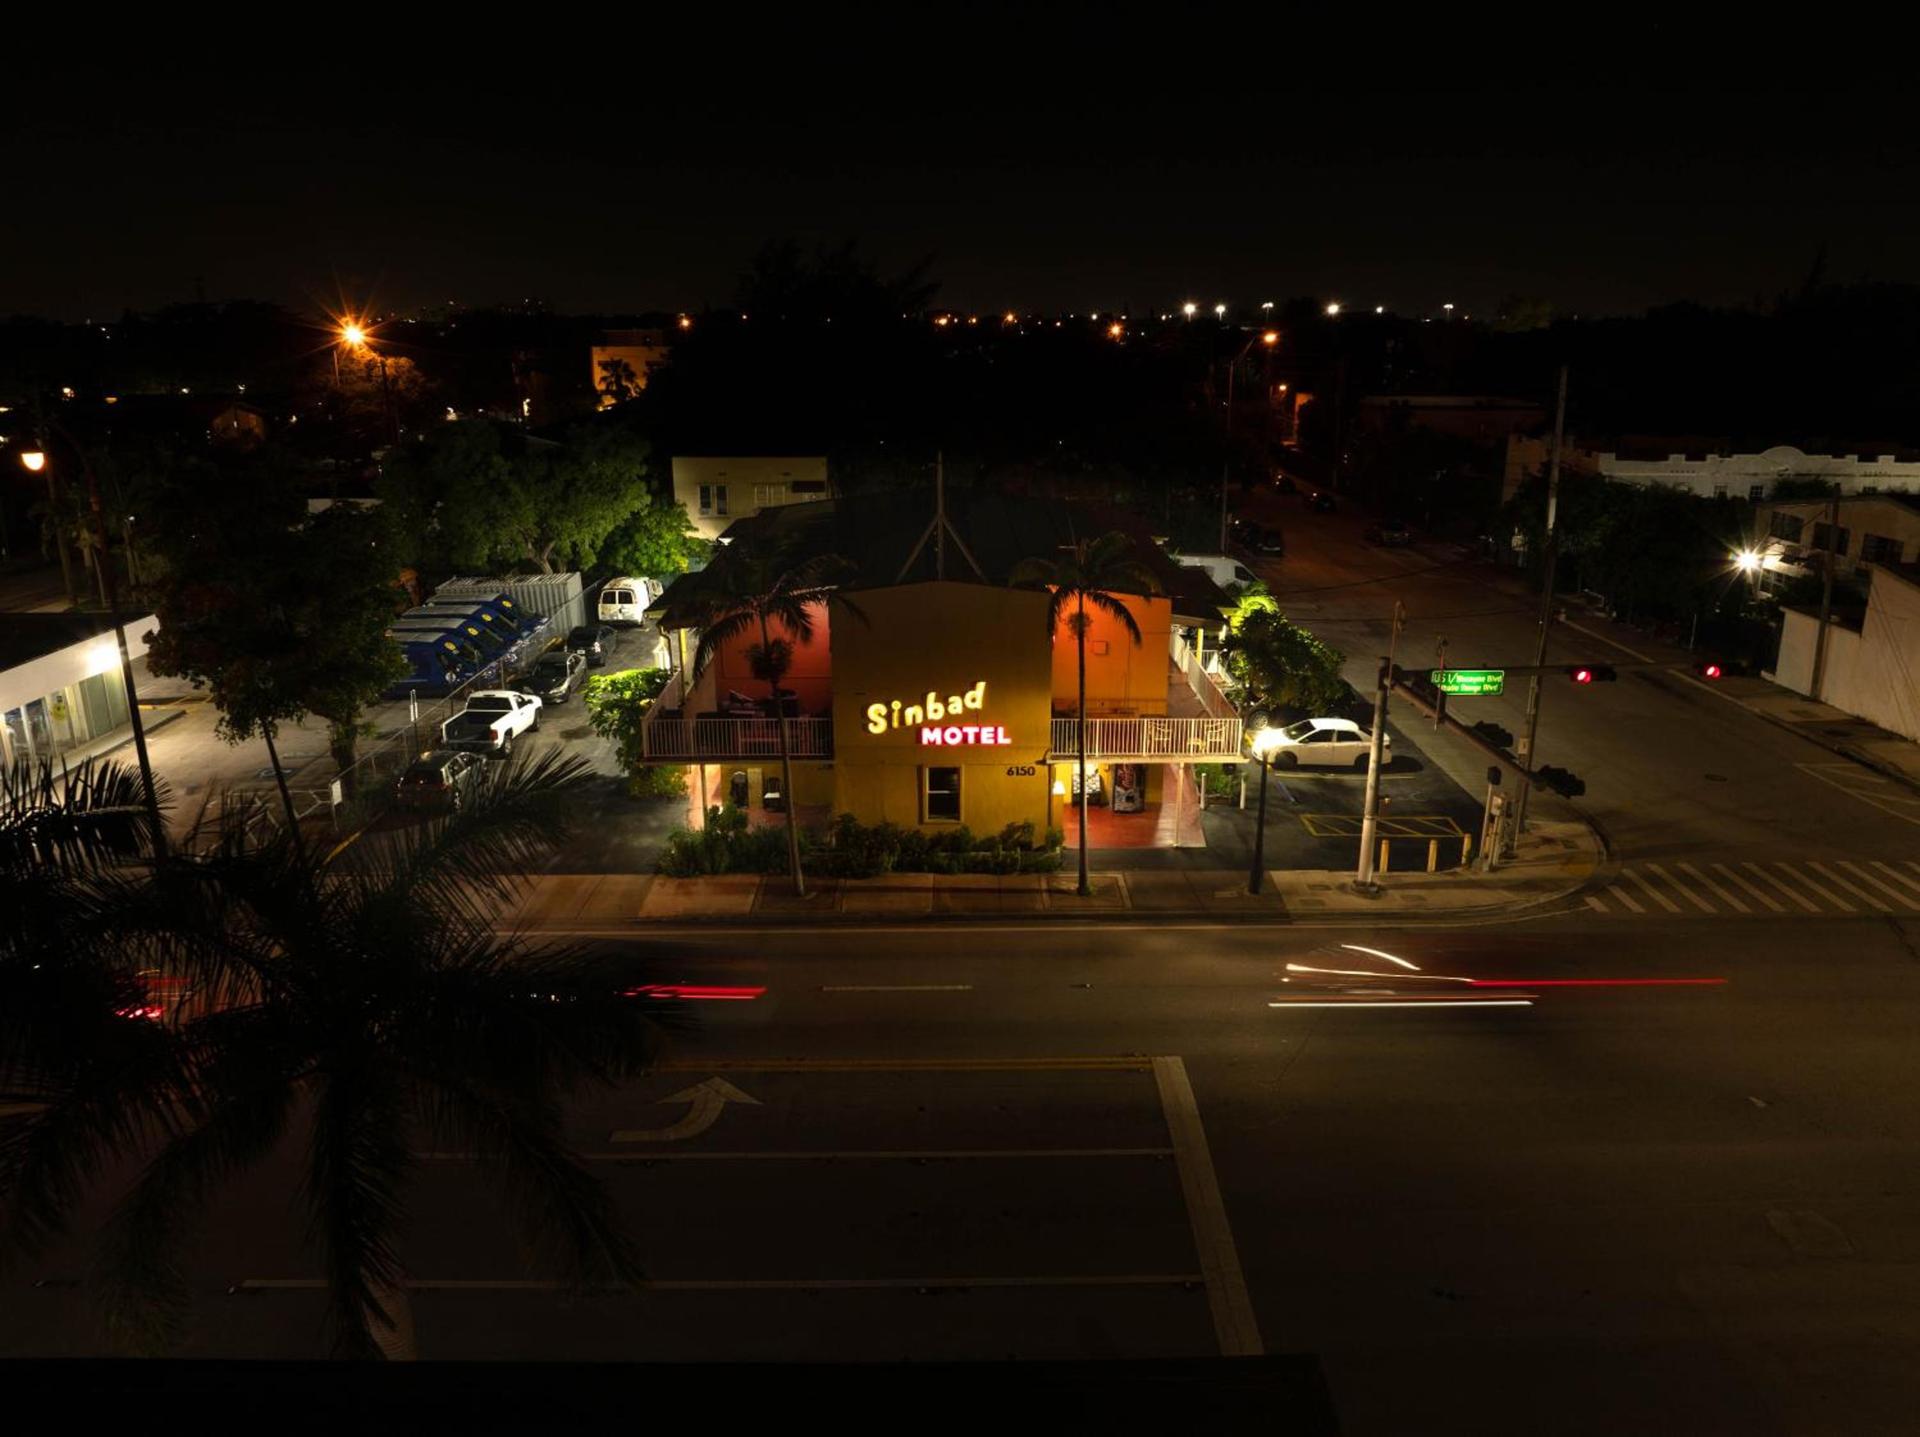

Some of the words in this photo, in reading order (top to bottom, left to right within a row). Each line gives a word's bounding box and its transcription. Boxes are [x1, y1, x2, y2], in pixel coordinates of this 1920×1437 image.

[867, 681, 986, 734] Sinbad
[921, 726, 1012, 745] MOTEL
[1006, 766, 1036, 777] 6150
